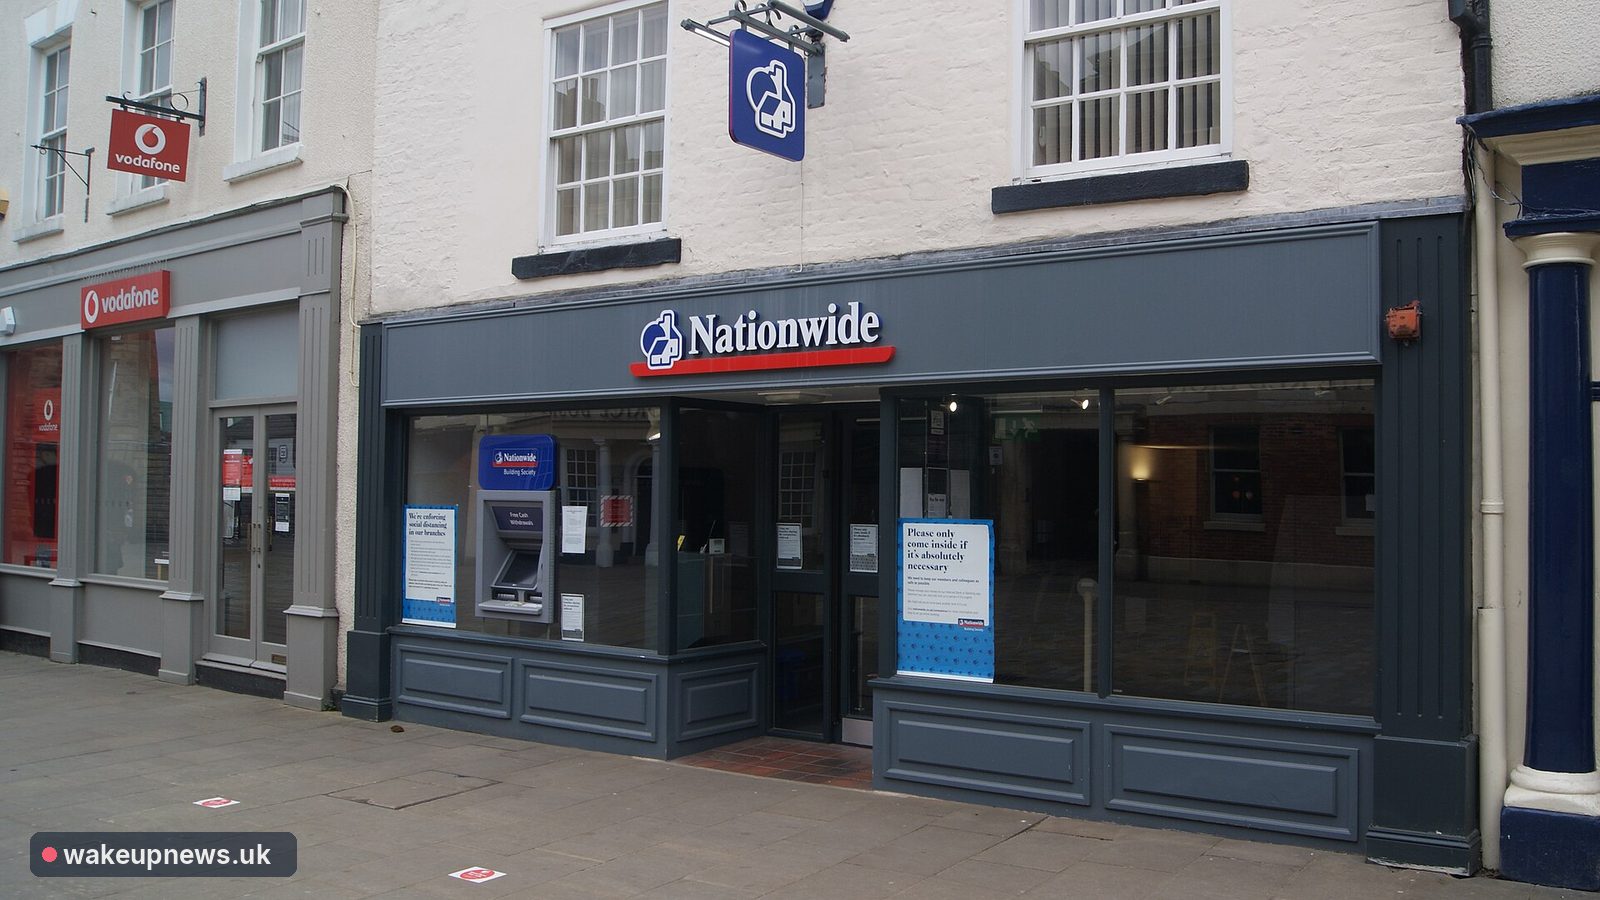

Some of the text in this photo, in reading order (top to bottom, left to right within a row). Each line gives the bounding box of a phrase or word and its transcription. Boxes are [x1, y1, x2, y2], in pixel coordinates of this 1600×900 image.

[115, 153, 181, 174] vodafone
[101, 285, 159, 313] vodafone
[688, 301, 881, 355] Nationwide
[38, 422, 59, 431] vodafone
[503, 452, 537, 462] Nationwide
[503, 468, 536, 476] Building Society
[408, 512, 447, 521] We're enforcing
[408, 520, 447, 529] social distancing
[424, 529, 446, 537] branches
[907, 528, 955, 541] Please only
[931, 539, 958, 549] inside
[960, 540, 969, 549] if
[907, 549, 965, 563] it's absolutely
[907, 563, 949, 574] necessary
